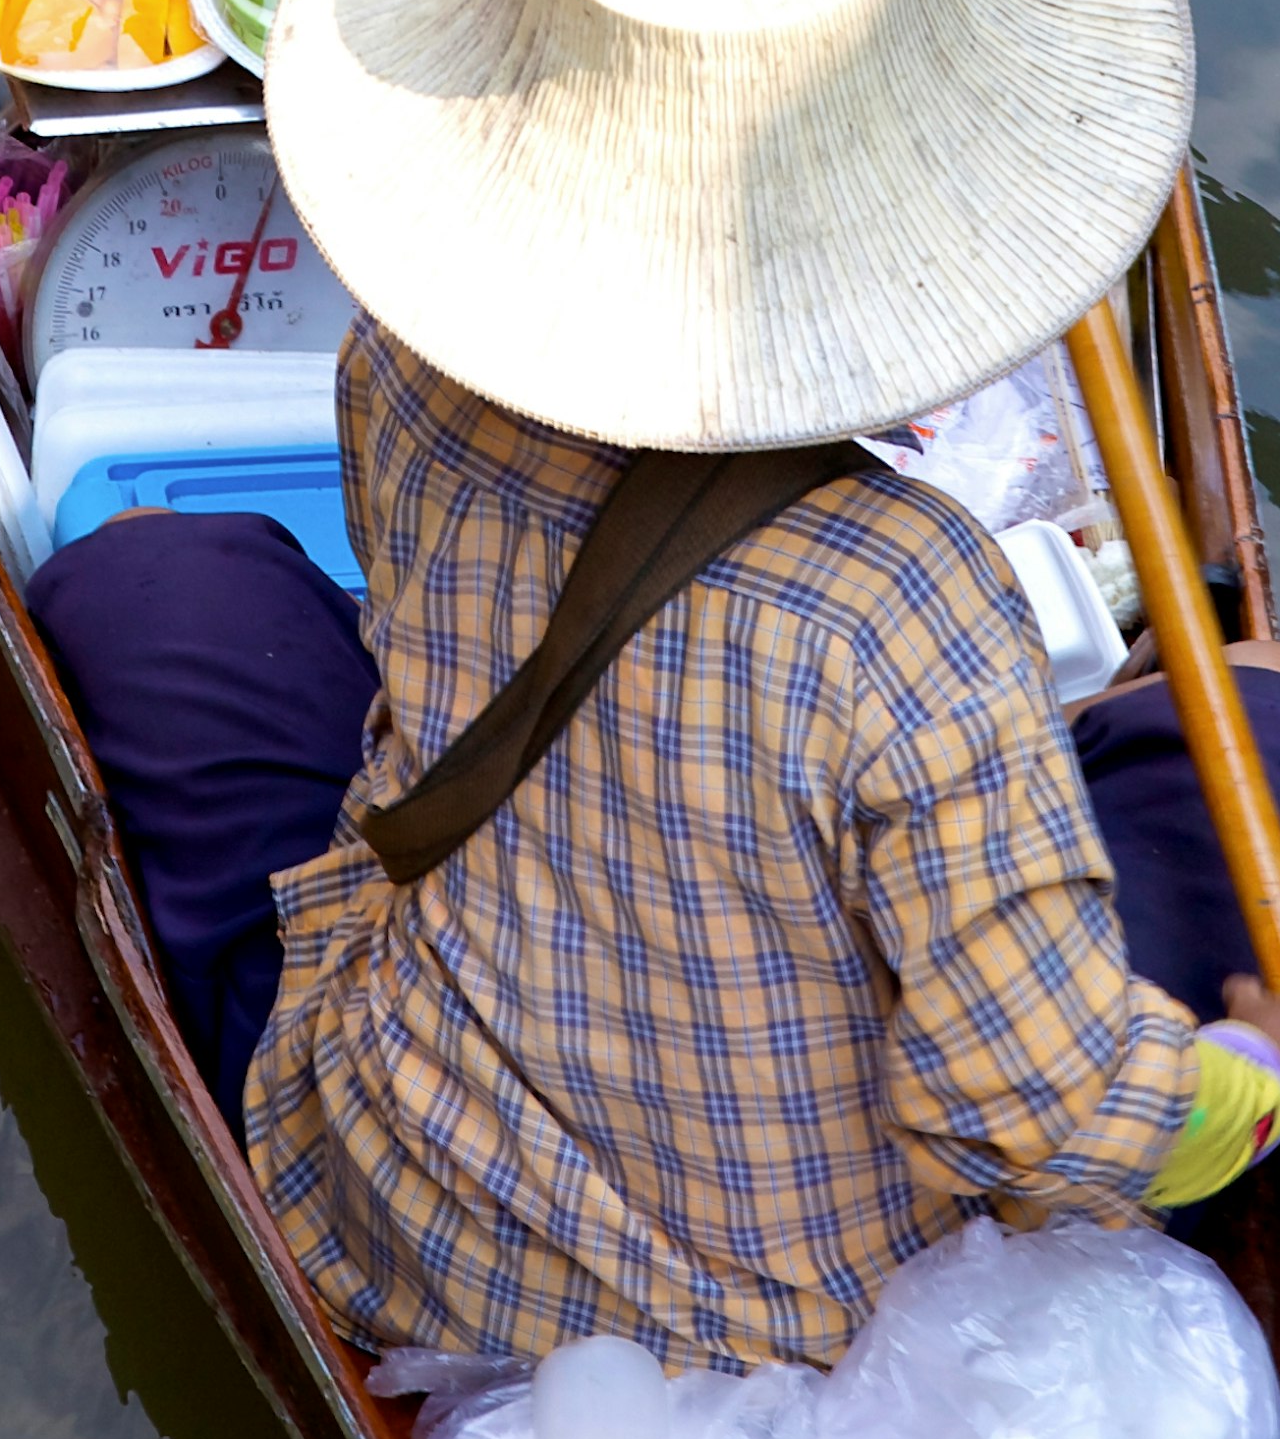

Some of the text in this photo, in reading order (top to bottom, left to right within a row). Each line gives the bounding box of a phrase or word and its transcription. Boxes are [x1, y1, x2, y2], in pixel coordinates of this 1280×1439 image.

[128, 219, 147, 236] 19
[102, 252, 121, 268] 18
[88, 286, 106, 302] 17
[81, 326, 100, 342] 16
